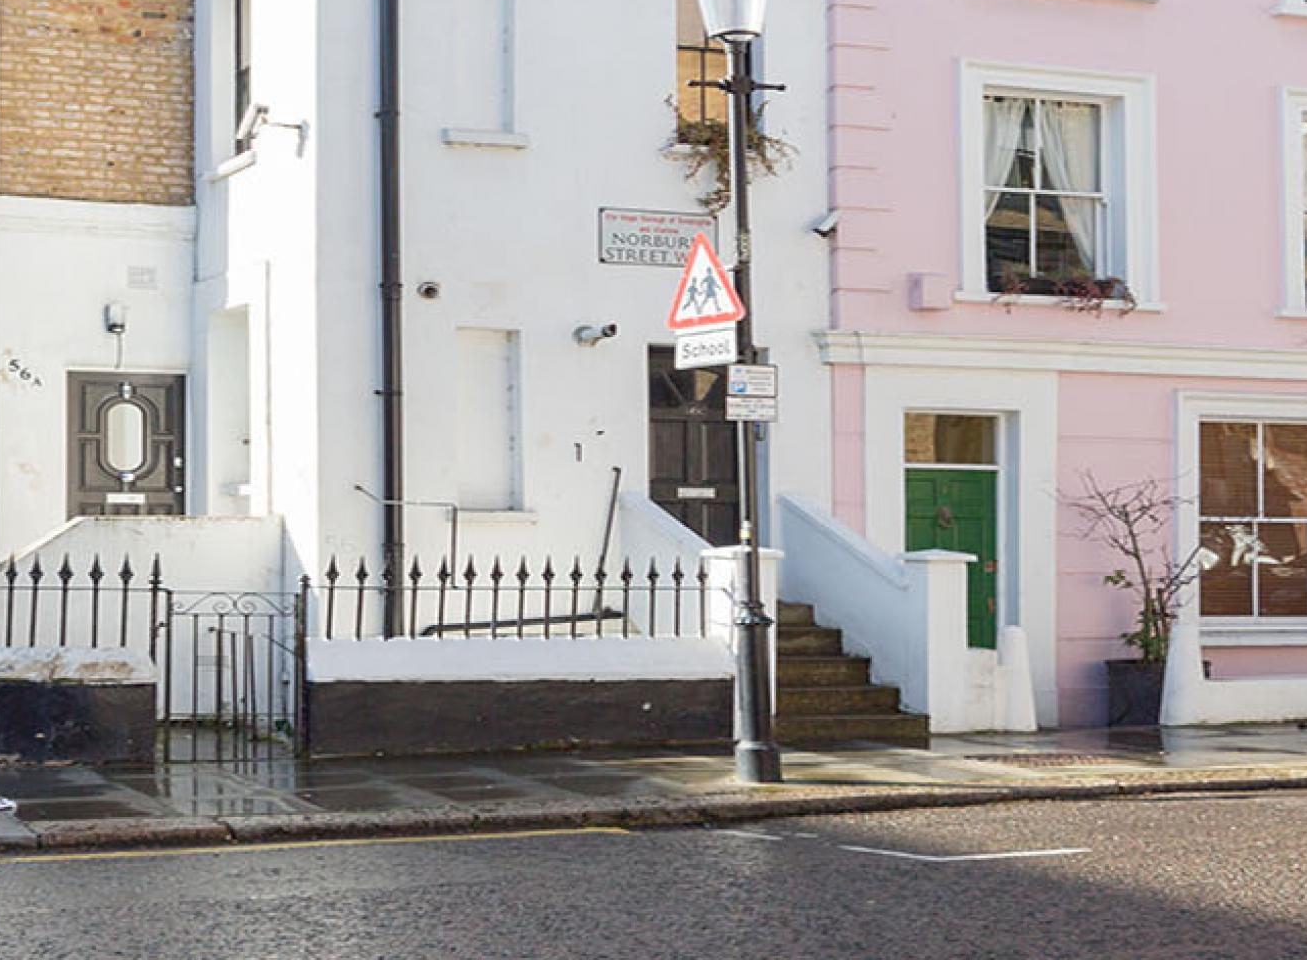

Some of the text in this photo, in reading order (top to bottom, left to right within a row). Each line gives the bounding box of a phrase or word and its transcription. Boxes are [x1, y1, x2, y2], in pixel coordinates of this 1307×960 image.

[612, 232, 695, 250] NORBUR
[604, 246, 670, 263] STREET
[682, 338, 732, 360] School
